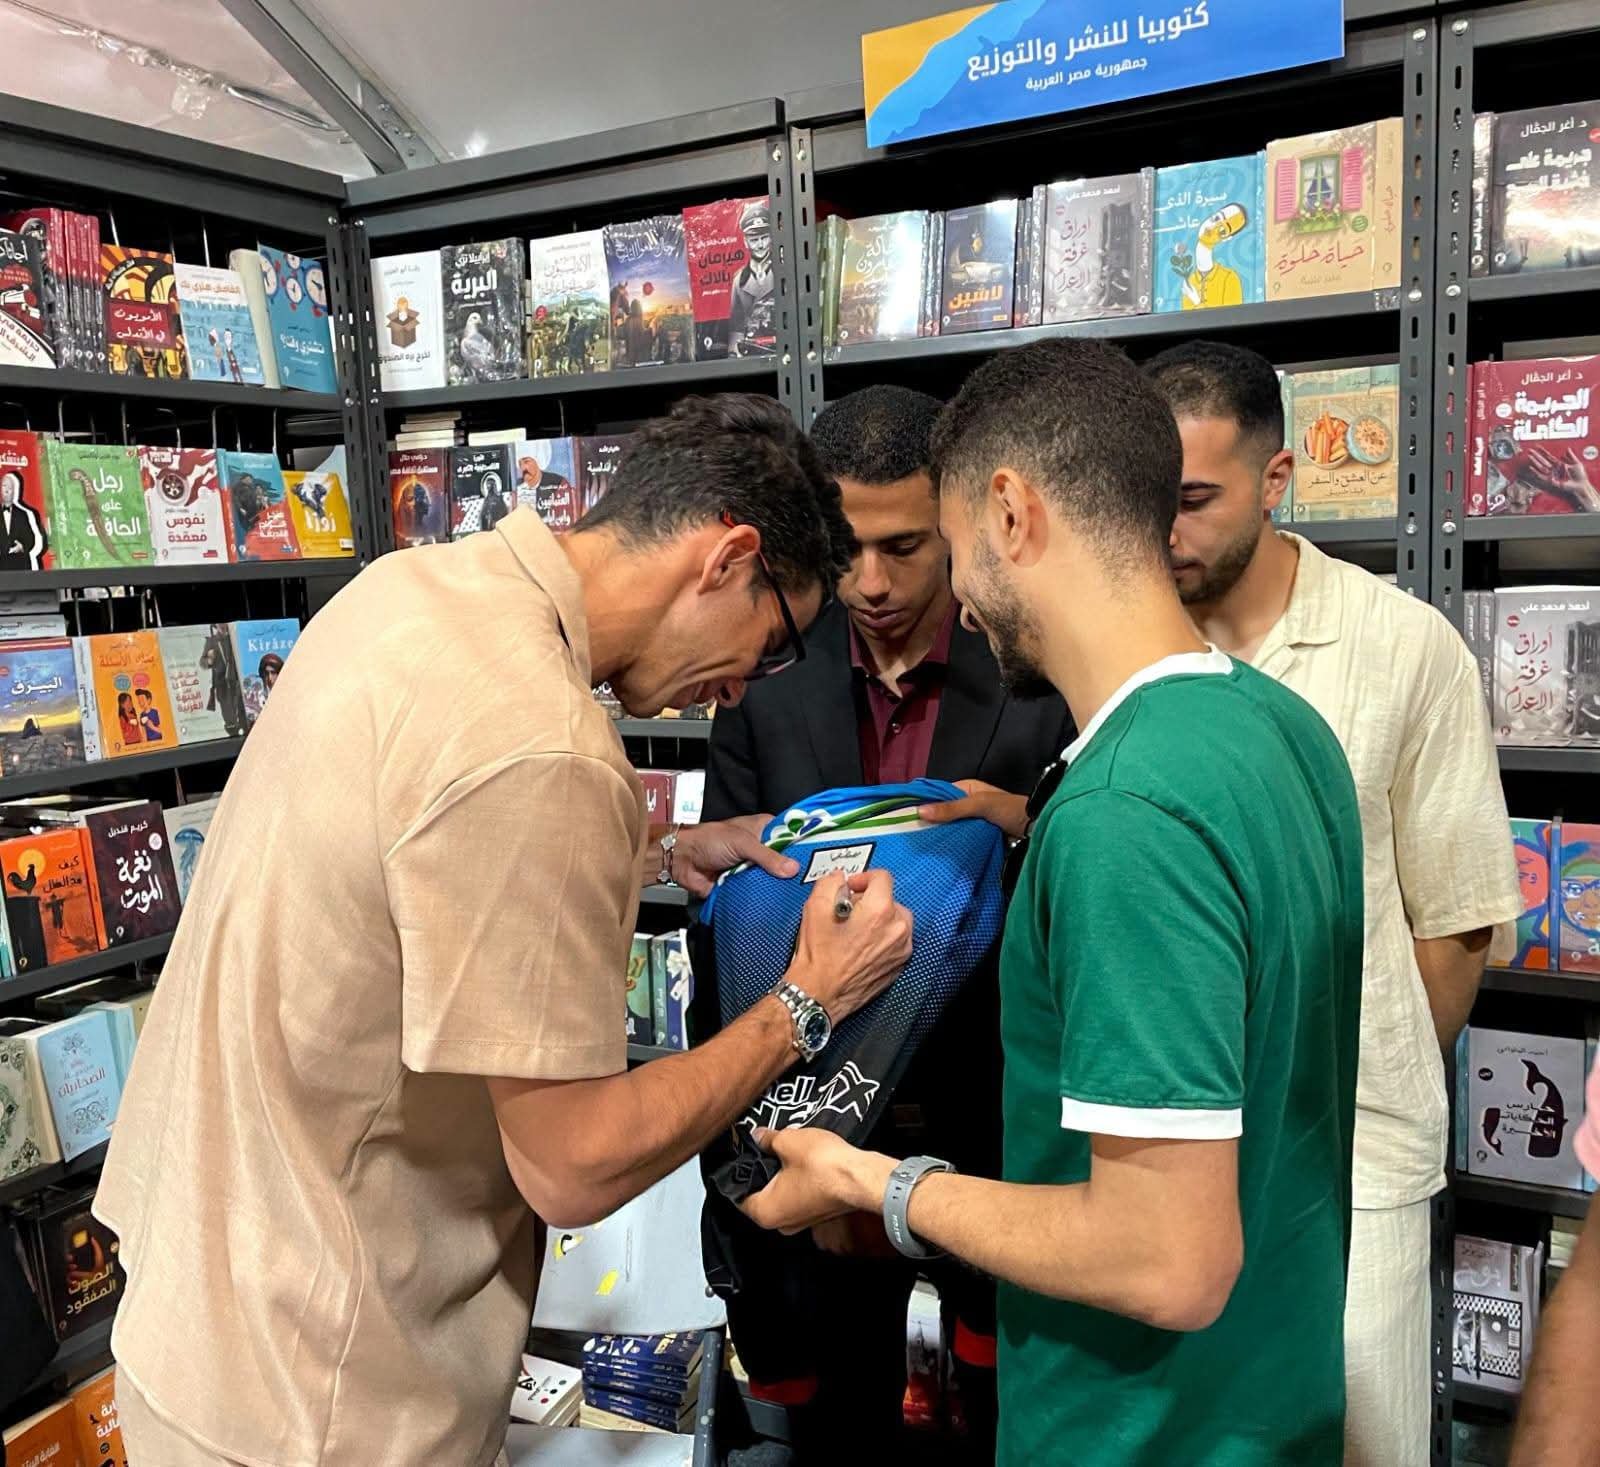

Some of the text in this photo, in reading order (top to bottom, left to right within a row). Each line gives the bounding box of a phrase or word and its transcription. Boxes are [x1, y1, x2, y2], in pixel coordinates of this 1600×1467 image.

[967, 1, 1209, 80] كتوبيا للنشر والتوزيع
[1025, 56, 1148, 90] جمهورية مصر العربية
[1154, 189, 1228, 215] سيرة الذي
[1273, 240, 1365, 277] حياة حلوة
[451, 269, 498, 300] البرية
[113, 307, 163, 322] الأمويون
[116, 326, 155, 339] الأندلس
[1514, 387, 1591, 418] الجريمة
[1512, 415, 1589, 441] الكاملة
[93, 467, 124, 493] رجل
[101, 499, 122, 513] على
[86, 516, 141, 537] الحافة
[166, 513, 206, 528] نفوس
[168, 529, 208, 543] معقدة
[1520, 600, 1591, 614] أحمد محمد علي
[11, 676, 63, 696] البيرق
[1517, 659, 1553, 687] غرفة
[130, 819, 149, 834] كريم
[58, 855, 80, 870] كيف
[115, 849, 152, 885] نغمة
[121, 874, 164, 914] الموت
[68, 1260, 115, 1296] الصوت
[66, 1279, 118, 1316] المفقود
